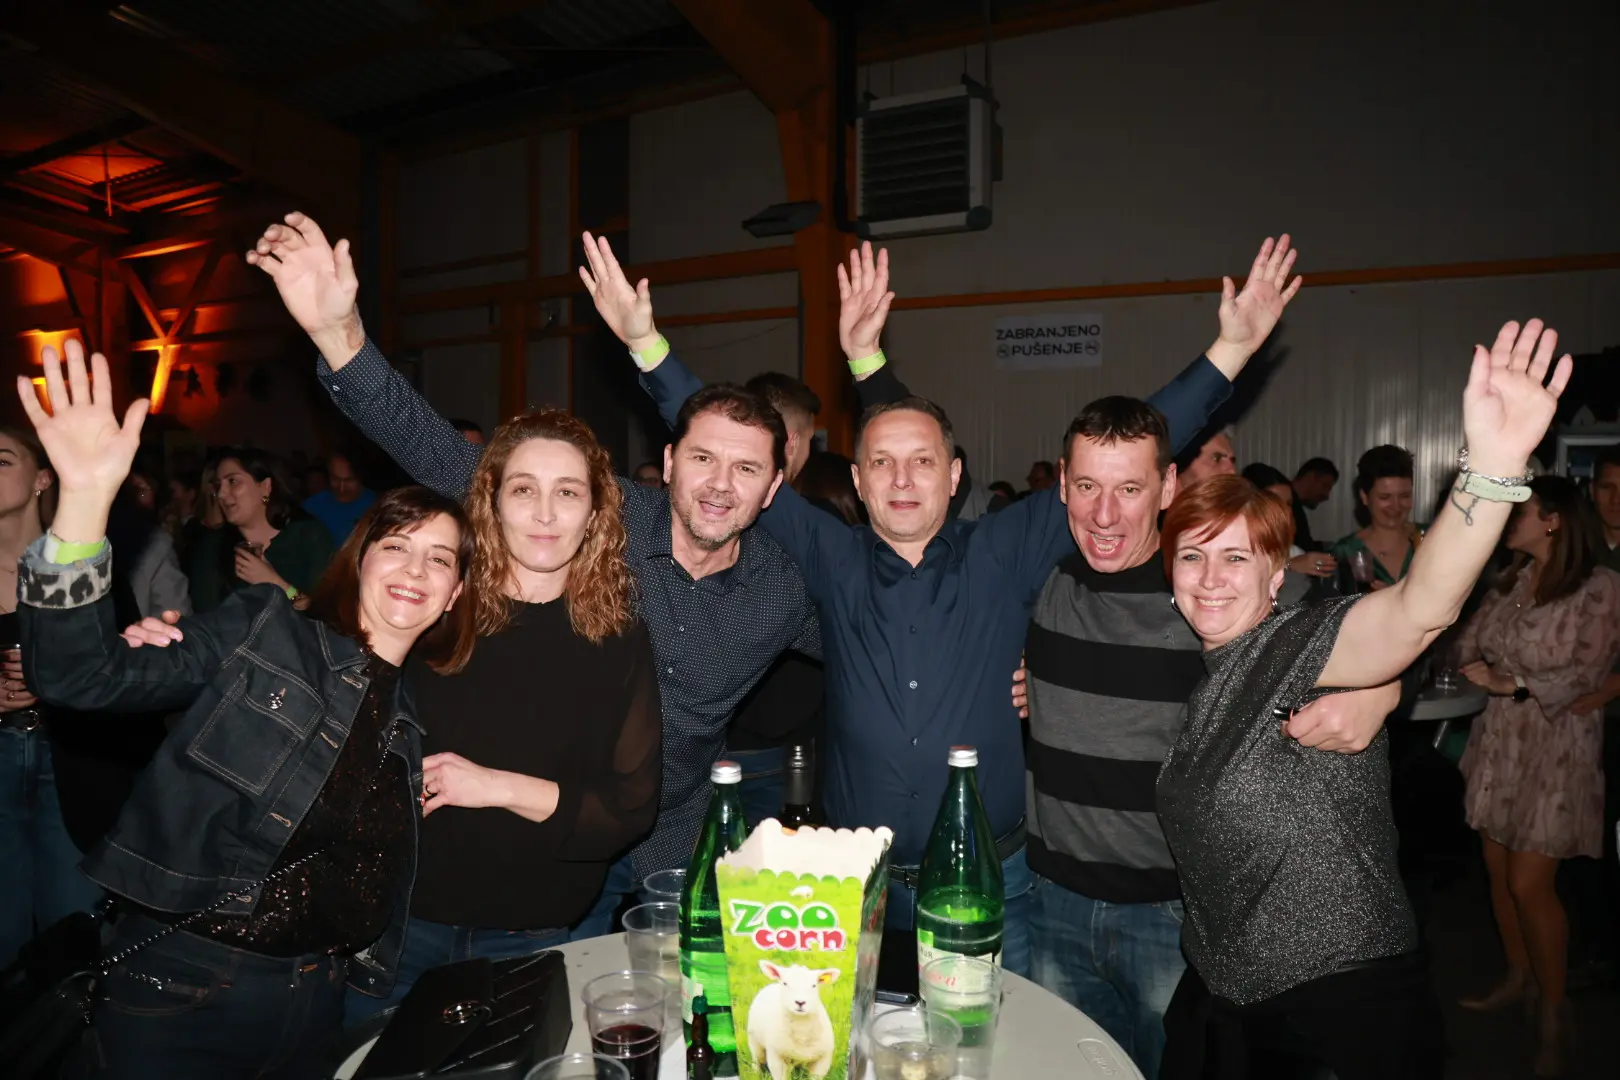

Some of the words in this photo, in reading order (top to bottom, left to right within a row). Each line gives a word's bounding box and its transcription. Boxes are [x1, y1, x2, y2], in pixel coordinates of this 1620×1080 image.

[996, 324, 1100, 340] ZABRANJENO
[1011, 342, 1082, 356] PUŠENJE
[755, 929, 843, 949] corn
